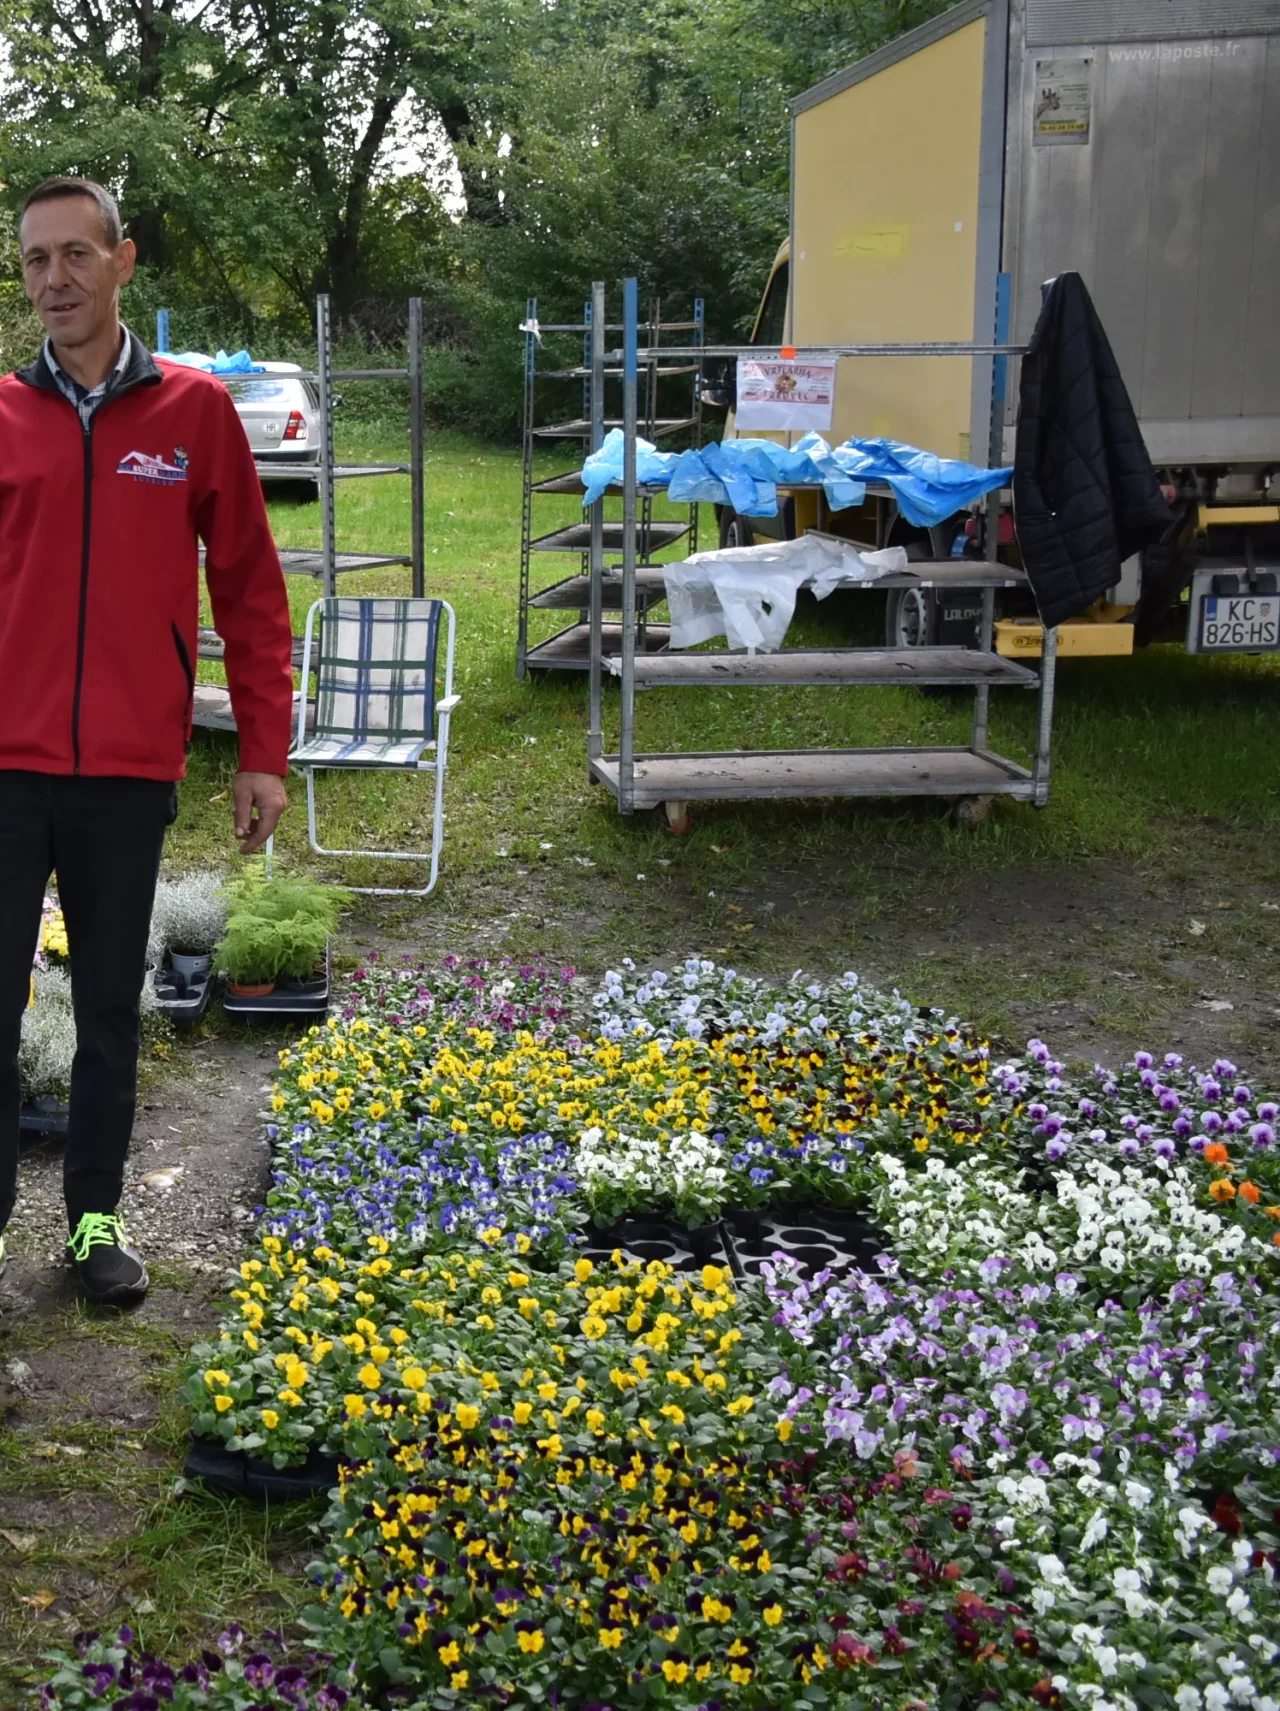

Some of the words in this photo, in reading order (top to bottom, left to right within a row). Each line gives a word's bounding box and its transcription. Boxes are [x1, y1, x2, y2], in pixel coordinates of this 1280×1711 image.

[1108, 41, 1241, 63] www.laposte.fr
[266, 422, 276, 432] HR
[1228, 600, 1256, 621] KC
[1206, 622, 1276, 645] 826-HS
